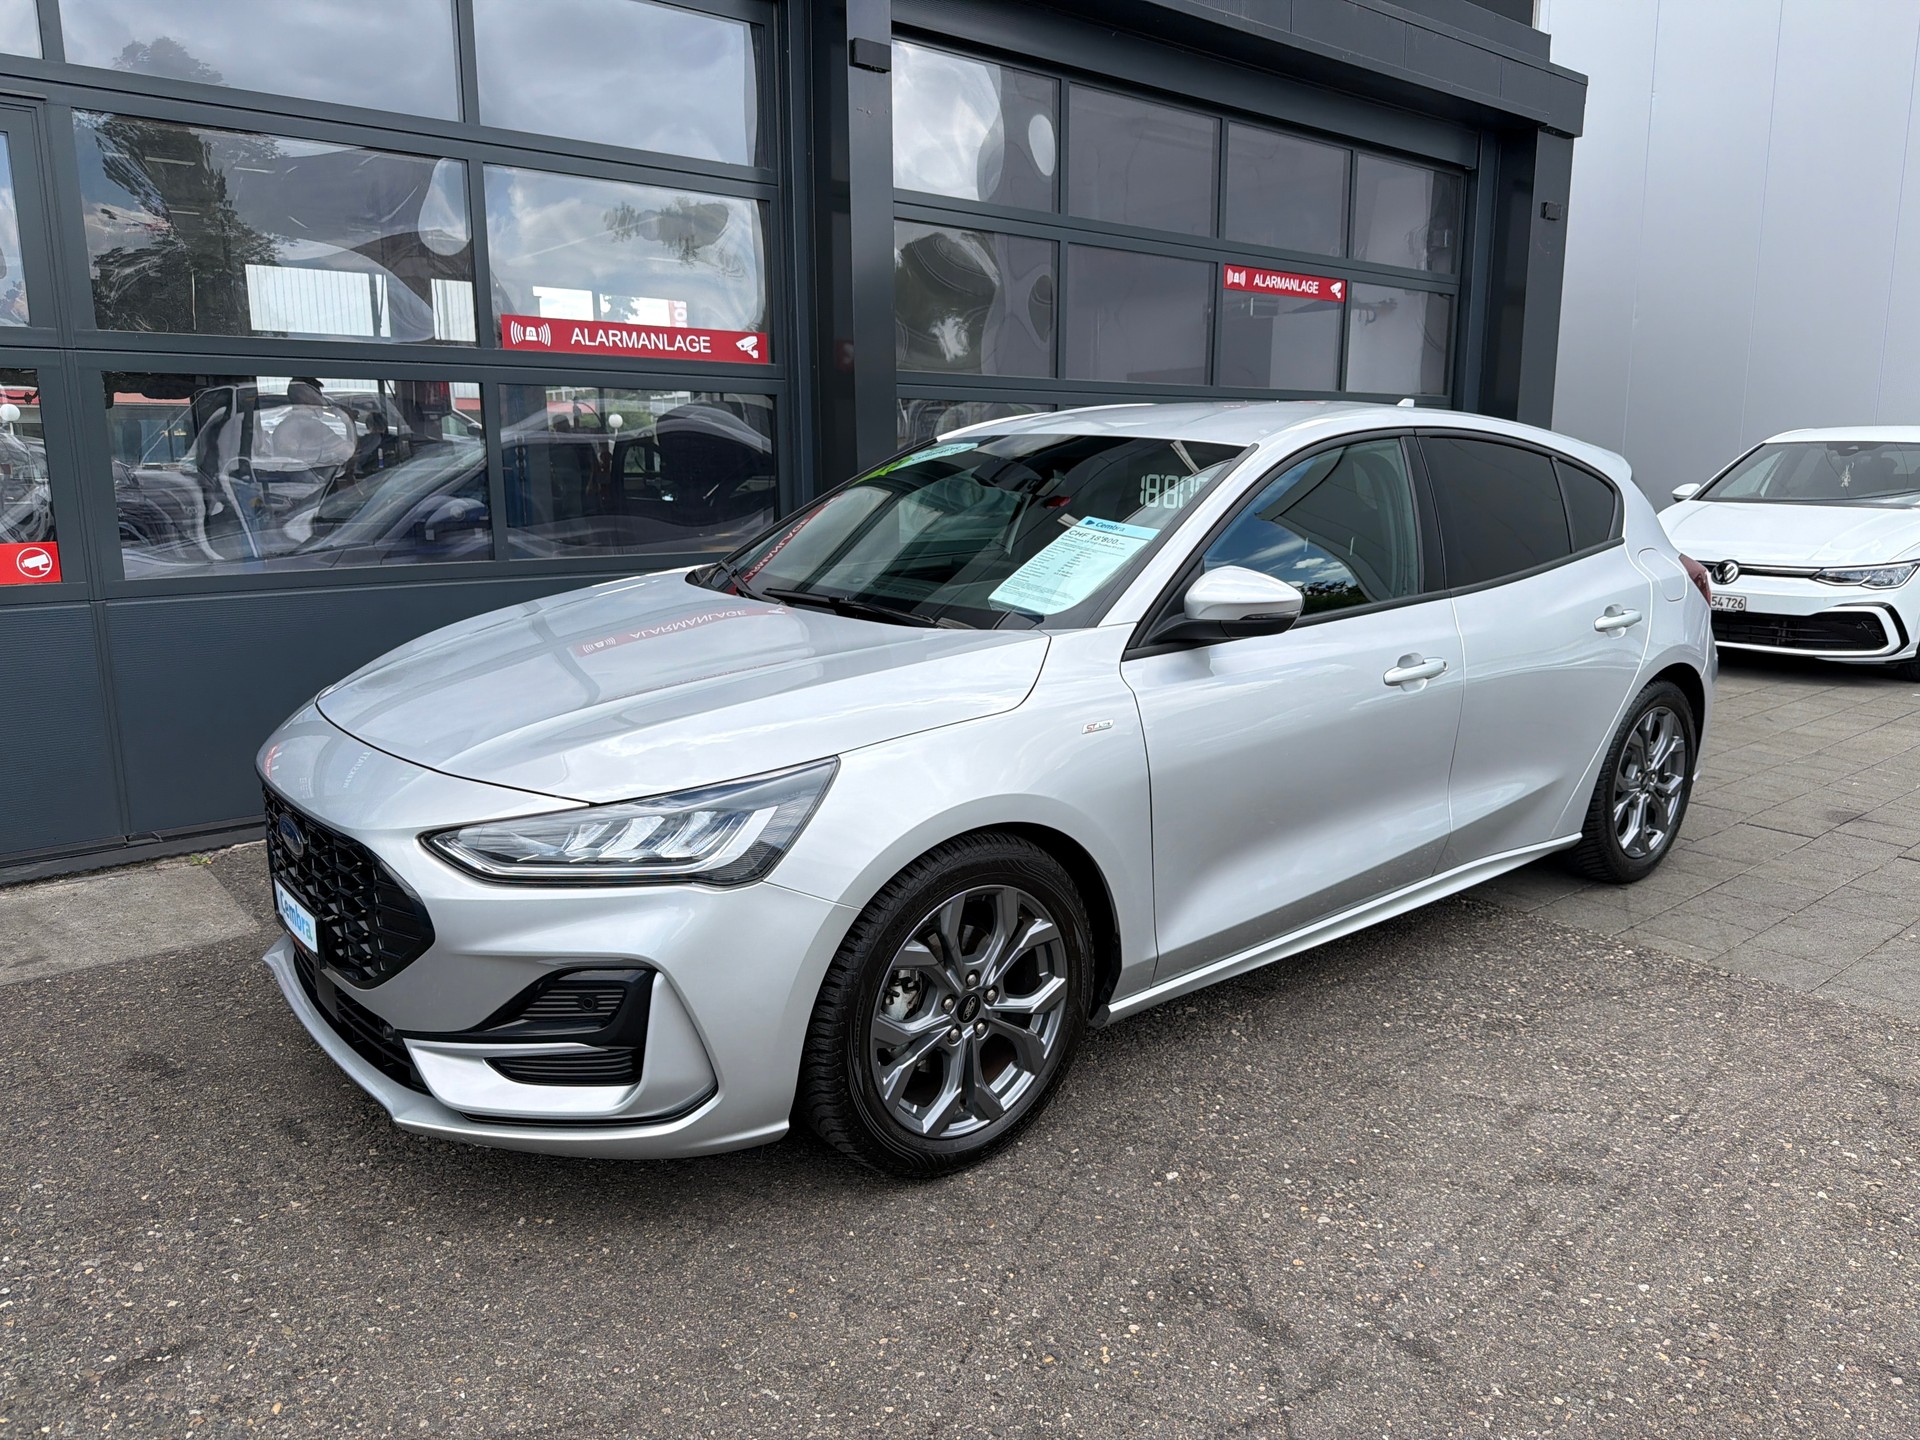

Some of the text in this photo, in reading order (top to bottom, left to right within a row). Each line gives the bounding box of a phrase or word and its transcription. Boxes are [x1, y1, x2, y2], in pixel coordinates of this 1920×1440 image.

[1253, 273, 1320, 294] ALARMANLAGE
[570, 327, 712, 353] ALARMANLAGE
[1068, 530, 1089, 540] CHF
[1725, 597, 1744, 609] 726
[279, 889, 314, 942] Cembra
